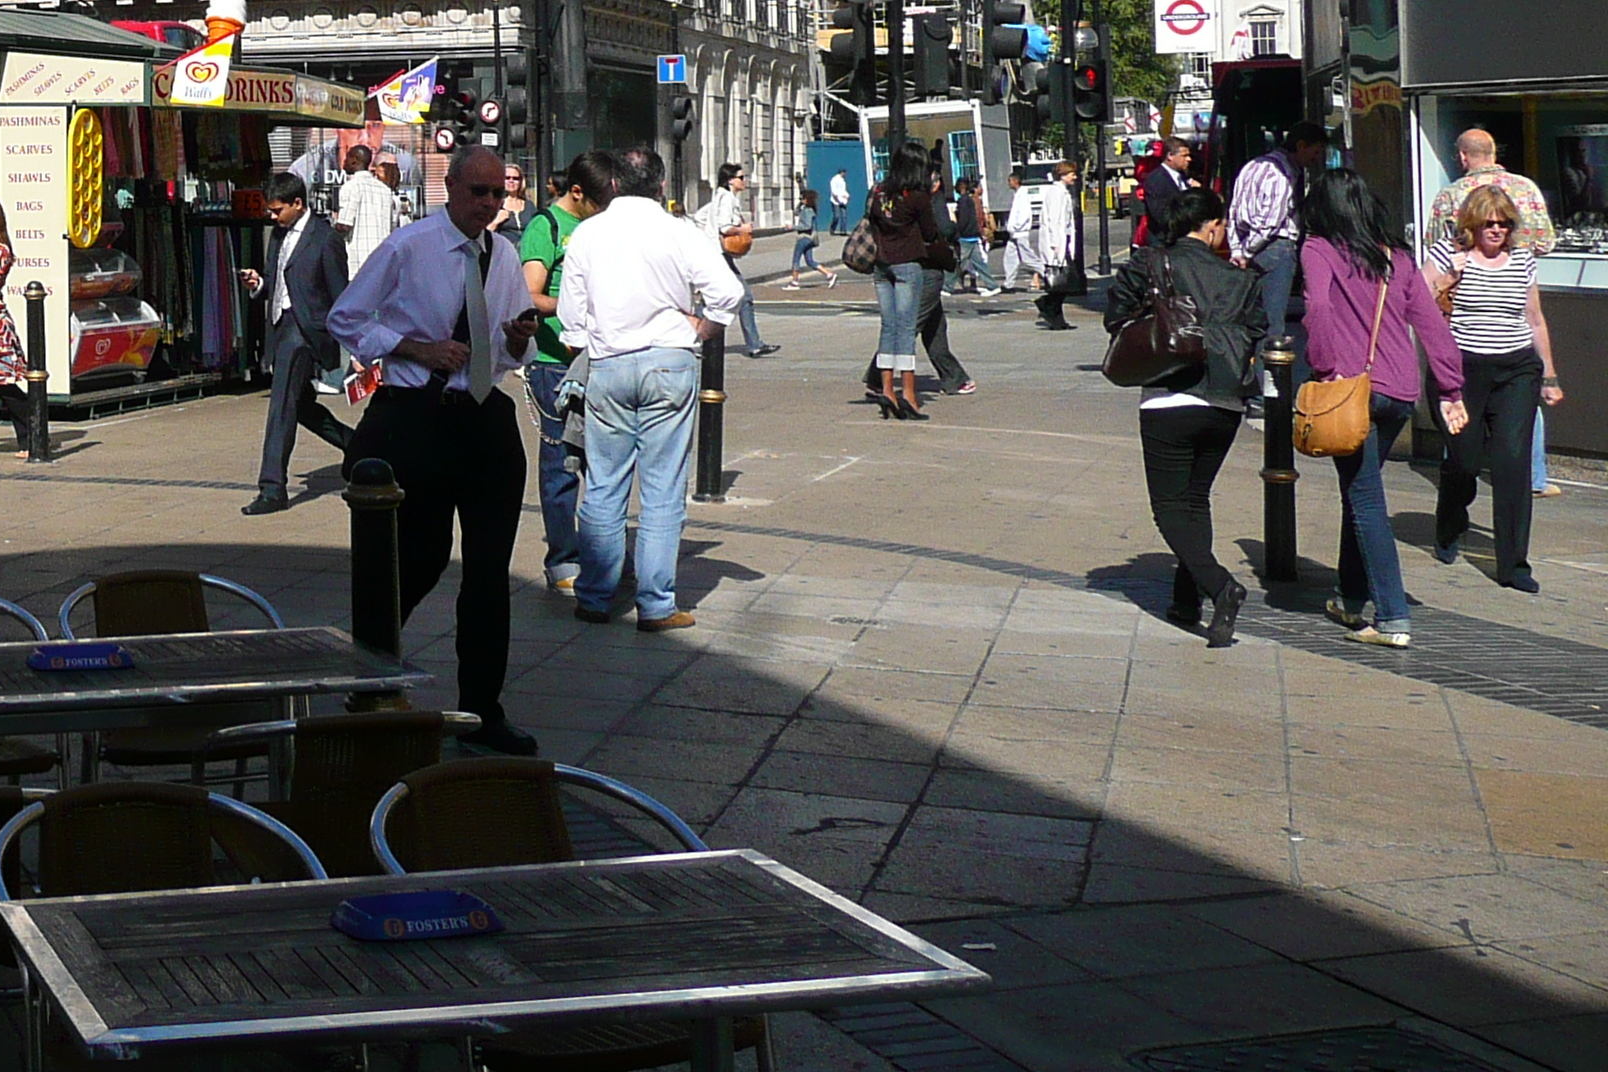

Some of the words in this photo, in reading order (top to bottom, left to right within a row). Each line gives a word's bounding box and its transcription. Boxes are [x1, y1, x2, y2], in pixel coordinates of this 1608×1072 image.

[5, 61, 45, 97] PASHMINAS
[64, 67, 96, 97] SCARVES
[5, 144, 53, 155] SCARVES
[8, 173, 51, 184] SHAWLS
[16, 201, 43, 212] BAGS
[15, 229, 45, 240] BELTS
